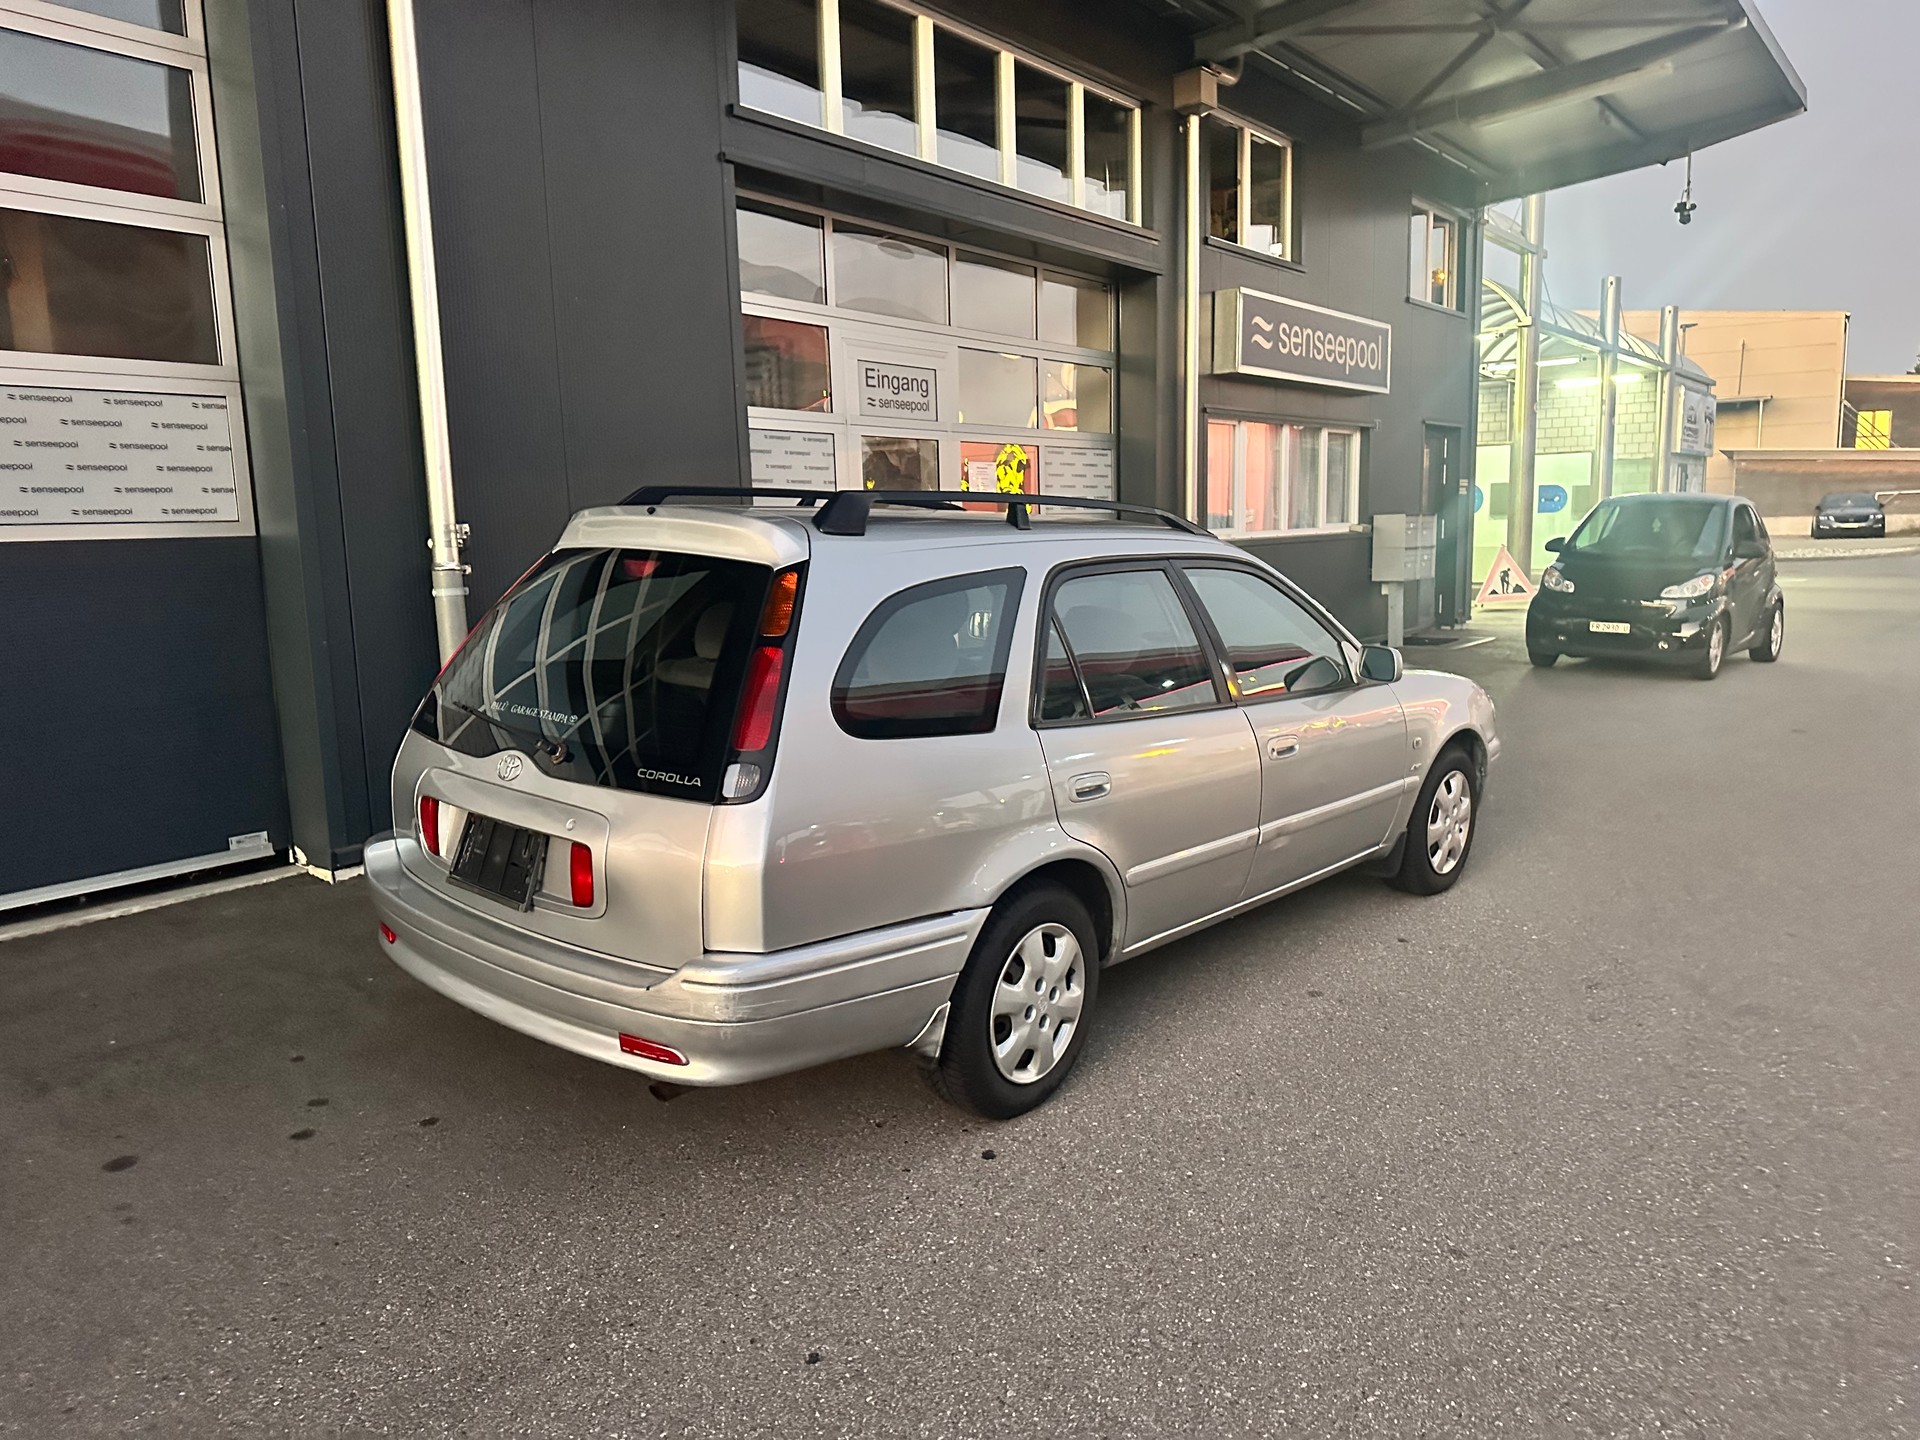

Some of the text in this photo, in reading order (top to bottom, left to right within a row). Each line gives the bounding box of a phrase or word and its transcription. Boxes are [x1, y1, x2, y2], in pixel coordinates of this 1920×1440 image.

[1279, 322, 1382, 374] senseepool
[865, 367, 929, 398] Eingang
[19, 394, 73, 403] senseepool
[114, 399, 163, 408] senseepool
[878, 398, 930, 413] senseepool
[71, 418, 123, 428] senseepool
[161, 422, 208, 431] senseepool
[25, 440, 79, 449] senseepool
[119, 443, 168, 451] senseepool
[76, 463, 128, 472] senseepool
[166, 464, 213, 473] senseepool
[30, 485, 84, 494] senseepool
[124, 486, 173, 494] senseepool
[82, 508, 133, 516] senseepool
[171, 507, 217, 515] senseepool
[510, 704, 539, 717] GARAGE
[538, 709, 568, 724] STAMPA
[637, 768, 701, 787] COROLLA
